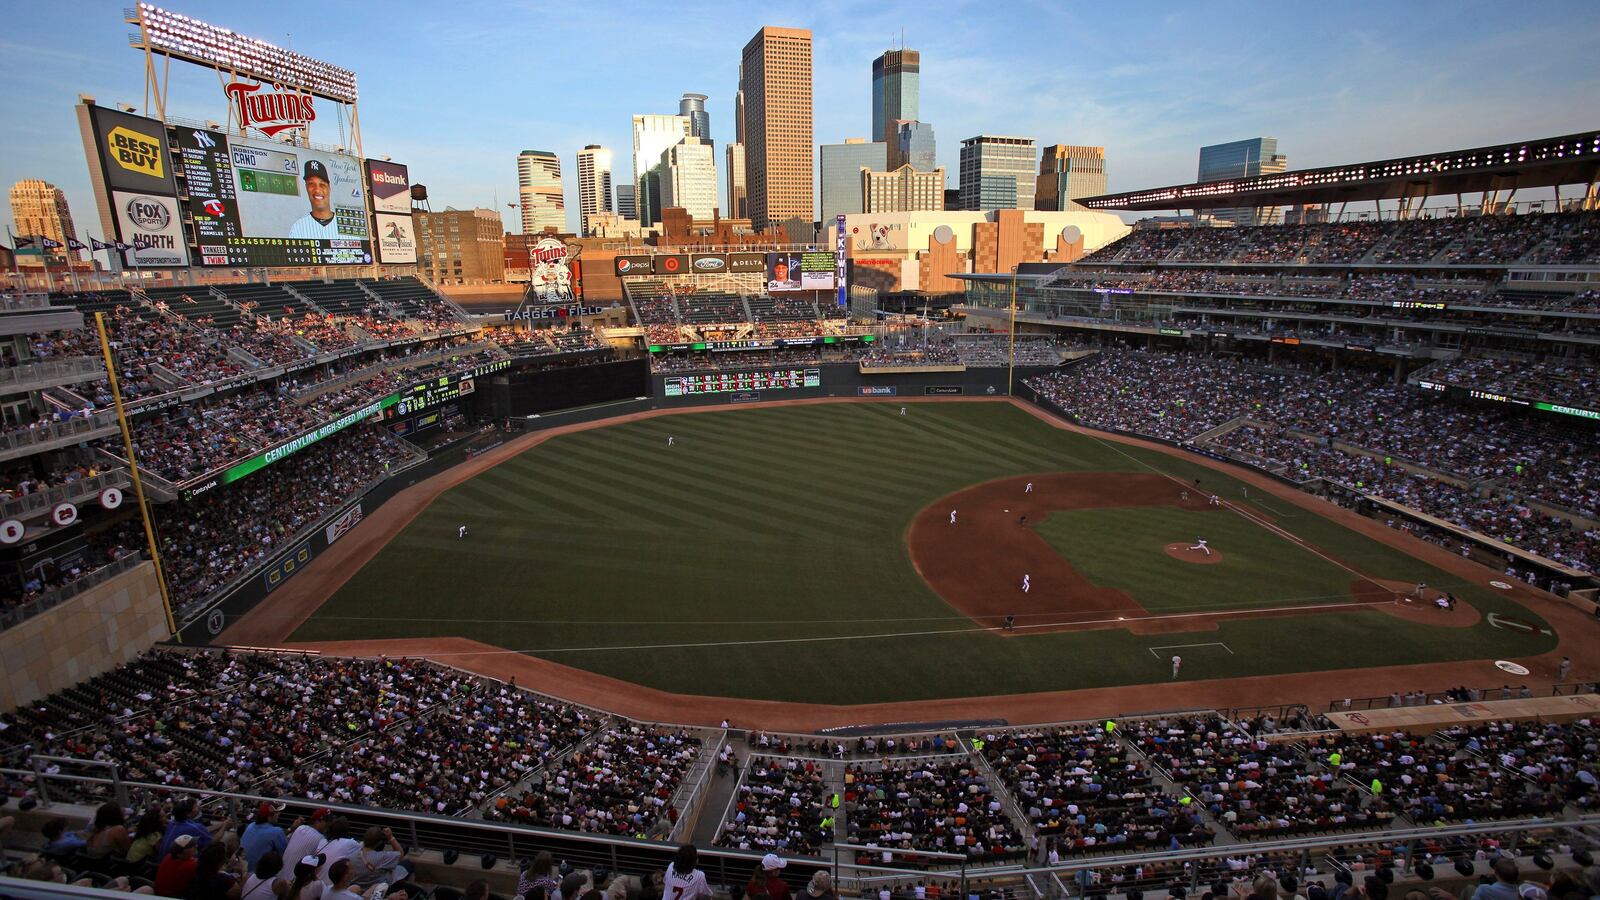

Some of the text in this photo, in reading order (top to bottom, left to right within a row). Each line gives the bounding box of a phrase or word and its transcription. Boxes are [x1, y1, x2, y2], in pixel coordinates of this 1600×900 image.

[224, 80, 316, 130] Twins
[114, 133, 159, 158] BEST
[233, 147, 268, 156] ROBINSON
[119, 151, 158, 170] BUY
[234, 152, 297, 171] CANO 24
[136, 202, 162, 219] FOX
[138, 217, 164, 226] SPORTS
[531, 246, 567, 266] Twins
[700, 260, 718, 269] Ford
[506, 306, 603, 321] TARGET FIELD
[265, 402, 382, 464] CENTURYLINK HIGH-SPEED INTERNET
[192, 480, 217, 496] CenturyLink
[108, 493, 116, 503] 3
[7, 526, 16, 537] 6
[672, 886, 683, 900] 7
